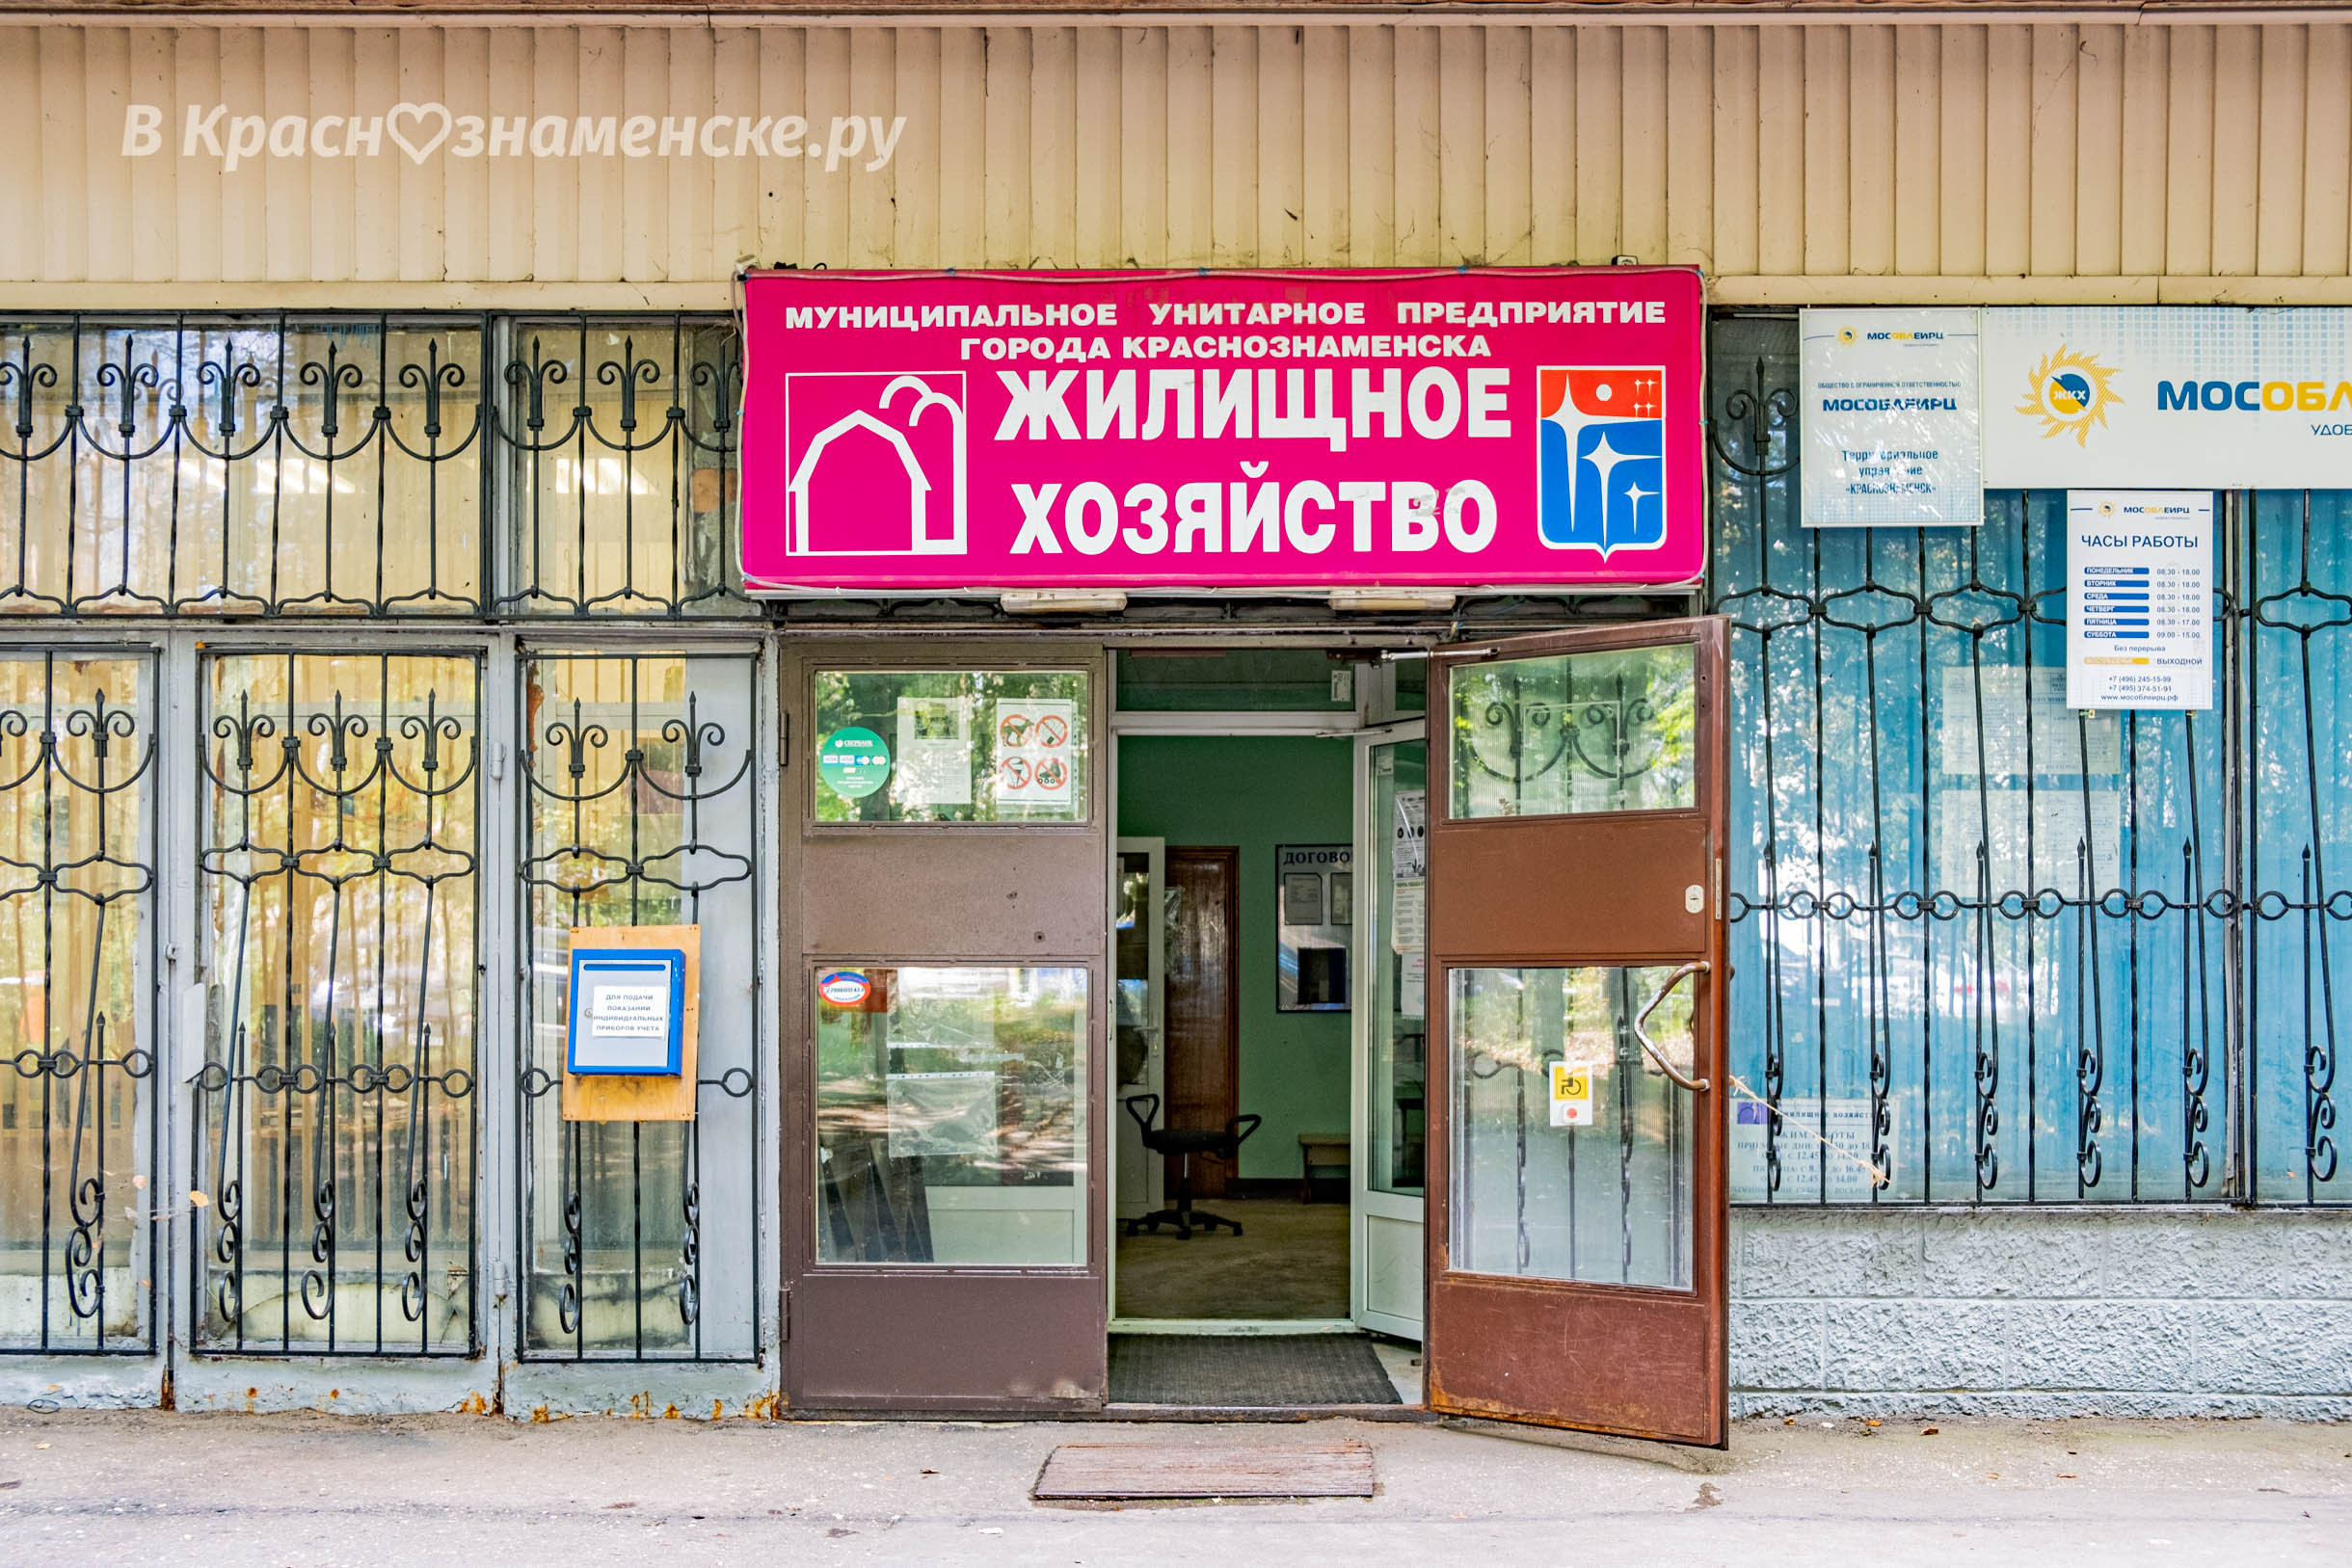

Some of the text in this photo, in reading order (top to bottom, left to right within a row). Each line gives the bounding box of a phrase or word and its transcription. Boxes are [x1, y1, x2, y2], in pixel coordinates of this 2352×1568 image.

[786, 301, 1666, 330] МУНИЦИПАЛЬНОЕ УНИТАРНОЕ ПРЕДПРИЯТИЕ
[961, 334, 1491, 362] ГОРОДА КРАСНОЗНАМЕНСКА
[994, 366, 1511, 452] ЖИЛИЩНОЕ
[2053, 389, 2087, 401] ЖКХ
[1009, 461, 1498, 555] ХОЗЯЙСТВО
[2081, 535, 2198, 547] ЧАСЫ РАБОТЫ
[1283, 851, 1352, 865] ДОГОВО
